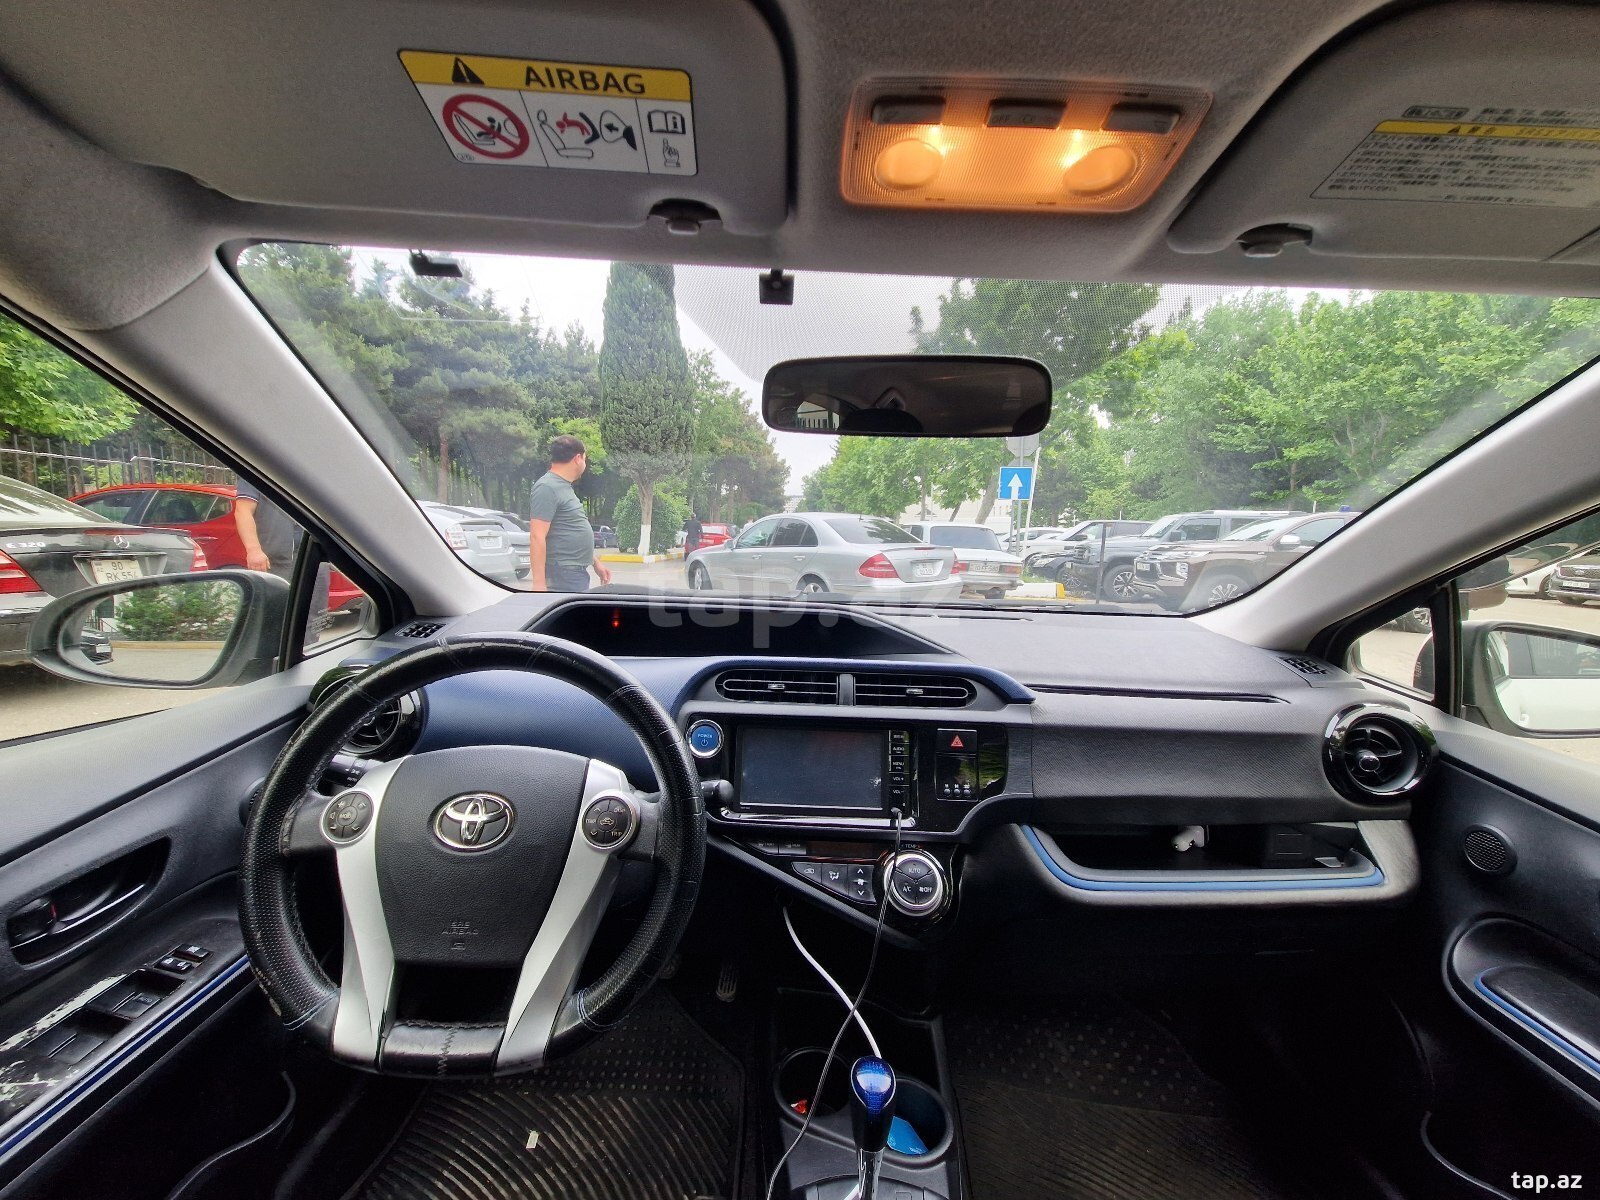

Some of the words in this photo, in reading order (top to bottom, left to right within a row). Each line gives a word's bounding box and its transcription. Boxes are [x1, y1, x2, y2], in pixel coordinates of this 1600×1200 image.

[525, 65, 646, 94] AIRBAG
[111, 561, 124, 571] 90
[105, 571, 121, 581] RK
